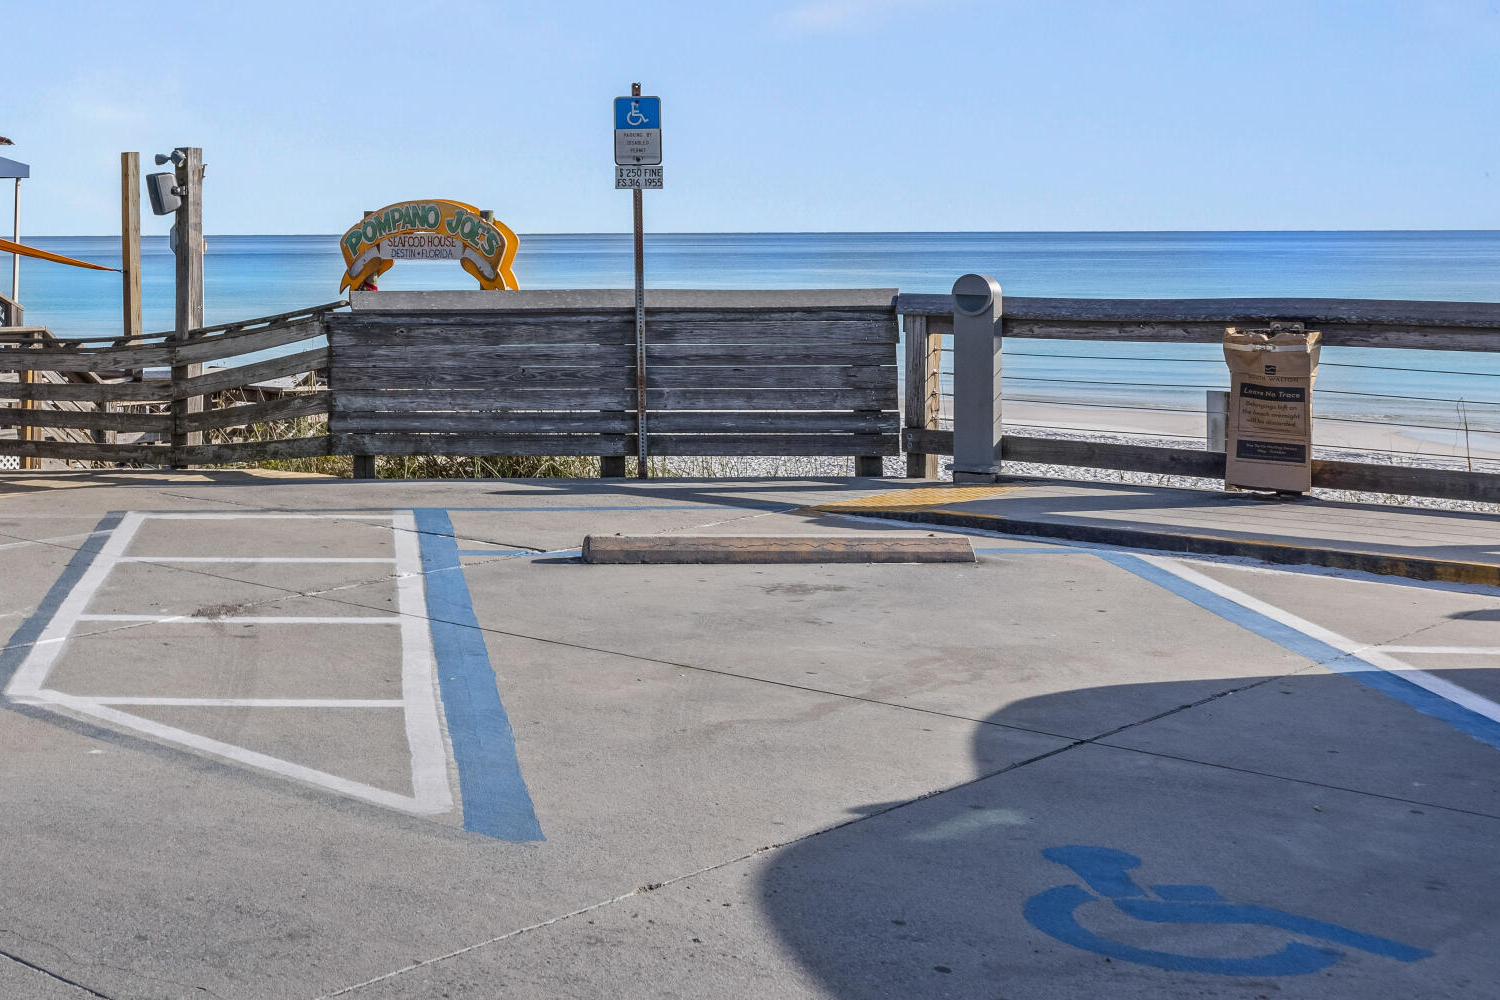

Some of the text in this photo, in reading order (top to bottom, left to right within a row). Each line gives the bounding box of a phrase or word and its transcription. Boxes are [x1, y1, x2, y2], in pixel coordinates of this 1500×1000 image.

[644, 168, 663, 177] FINE
[343, 203, 500, 258] POMPANO JOE'S
[387, 235, 457, 248] SEAFOOD HOUSE
[390, 248, 453, 259] DESTIN FLORIDA
[1243, 386, 1264, 397] Leave
[1278, 391, 1301, 399] Trace
